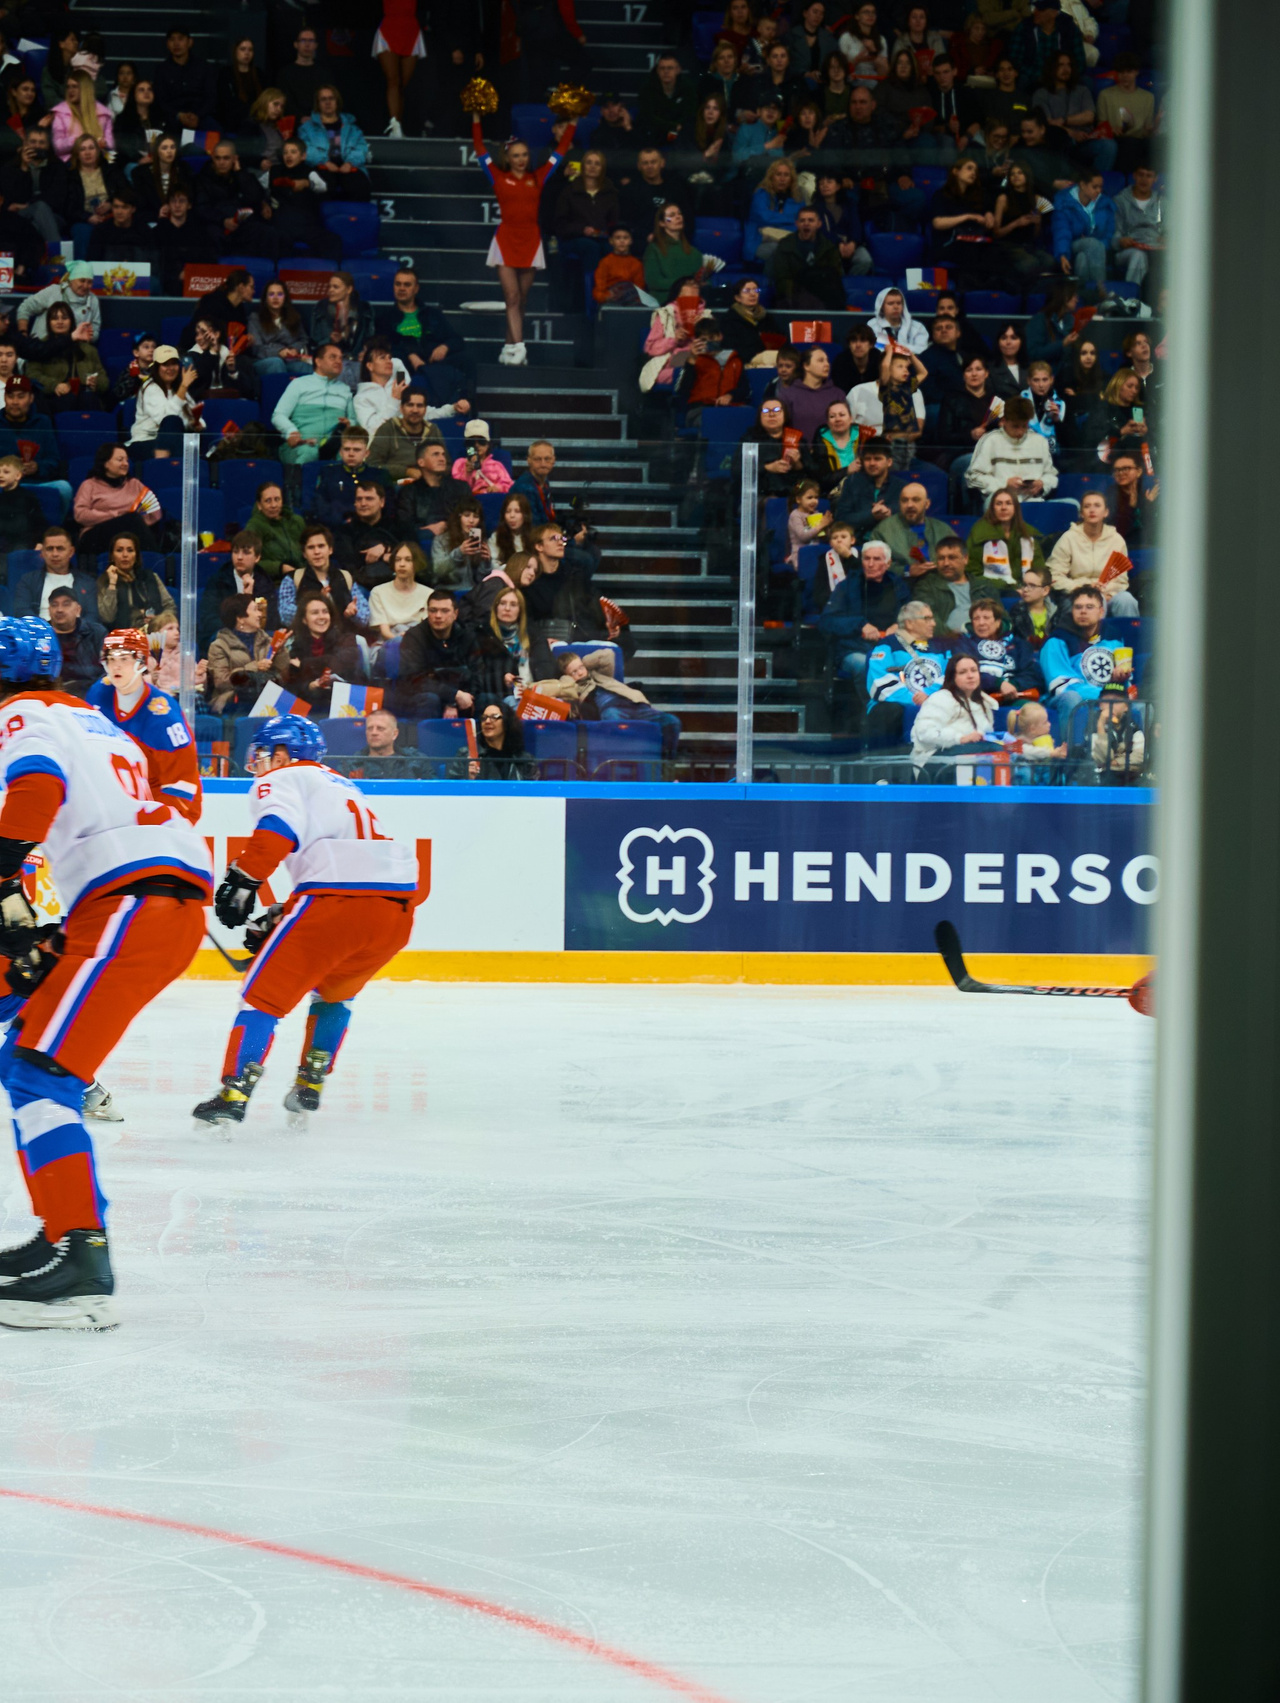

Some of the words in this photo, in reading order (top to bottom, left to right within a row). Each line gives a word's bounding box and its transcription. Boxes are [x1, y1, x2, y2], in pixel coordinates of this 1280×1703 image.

[624, 3, 648, 23] 17
[530, 319, 553, 342] 11
[166, 721, 189, 748] 18
